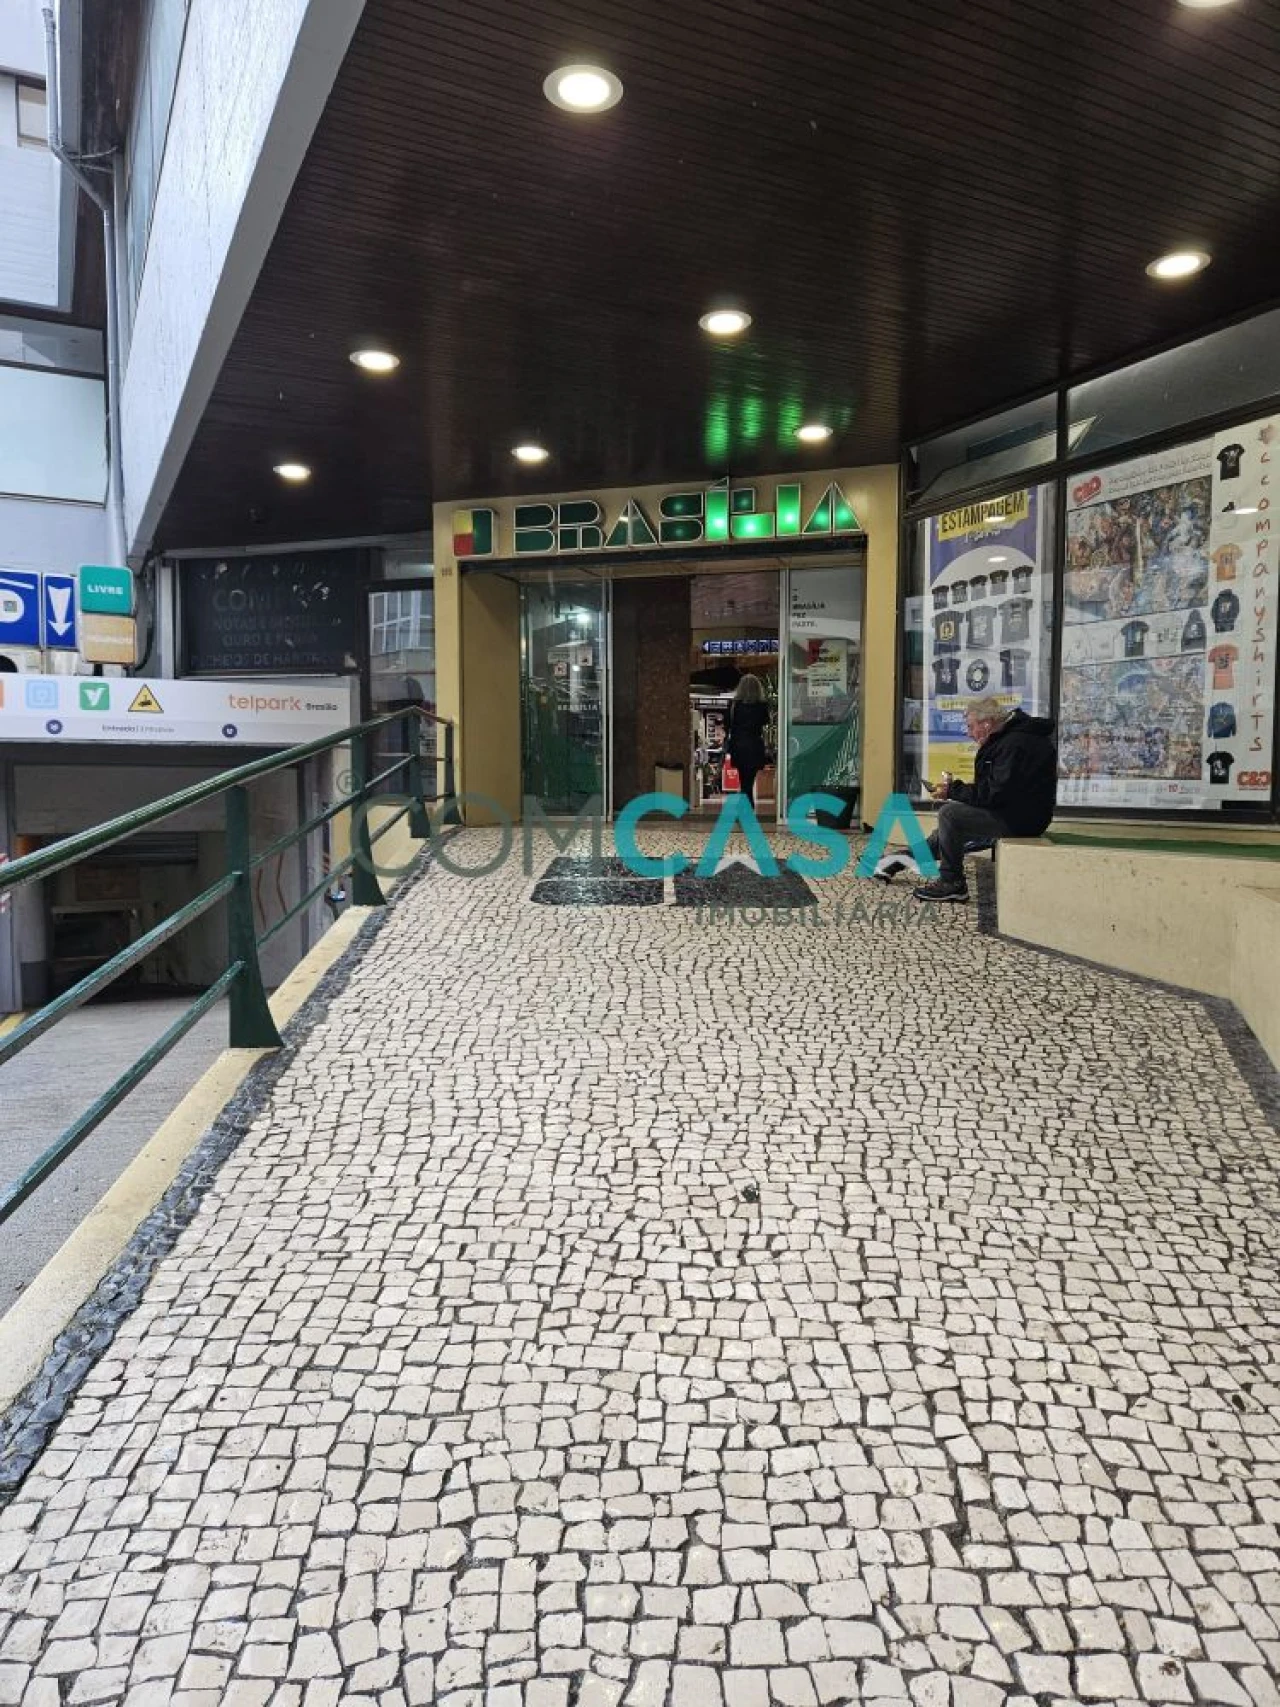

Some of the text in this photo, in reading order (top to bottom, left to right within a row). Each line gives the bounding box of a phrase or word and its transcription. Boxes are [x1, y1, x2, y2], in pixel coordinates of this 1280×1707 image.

[941, 490, 1026, 534] ESTAMPAGEM
[87, 583, 124, 596] LIVRE
[228, 693, 302, 716] telpark
